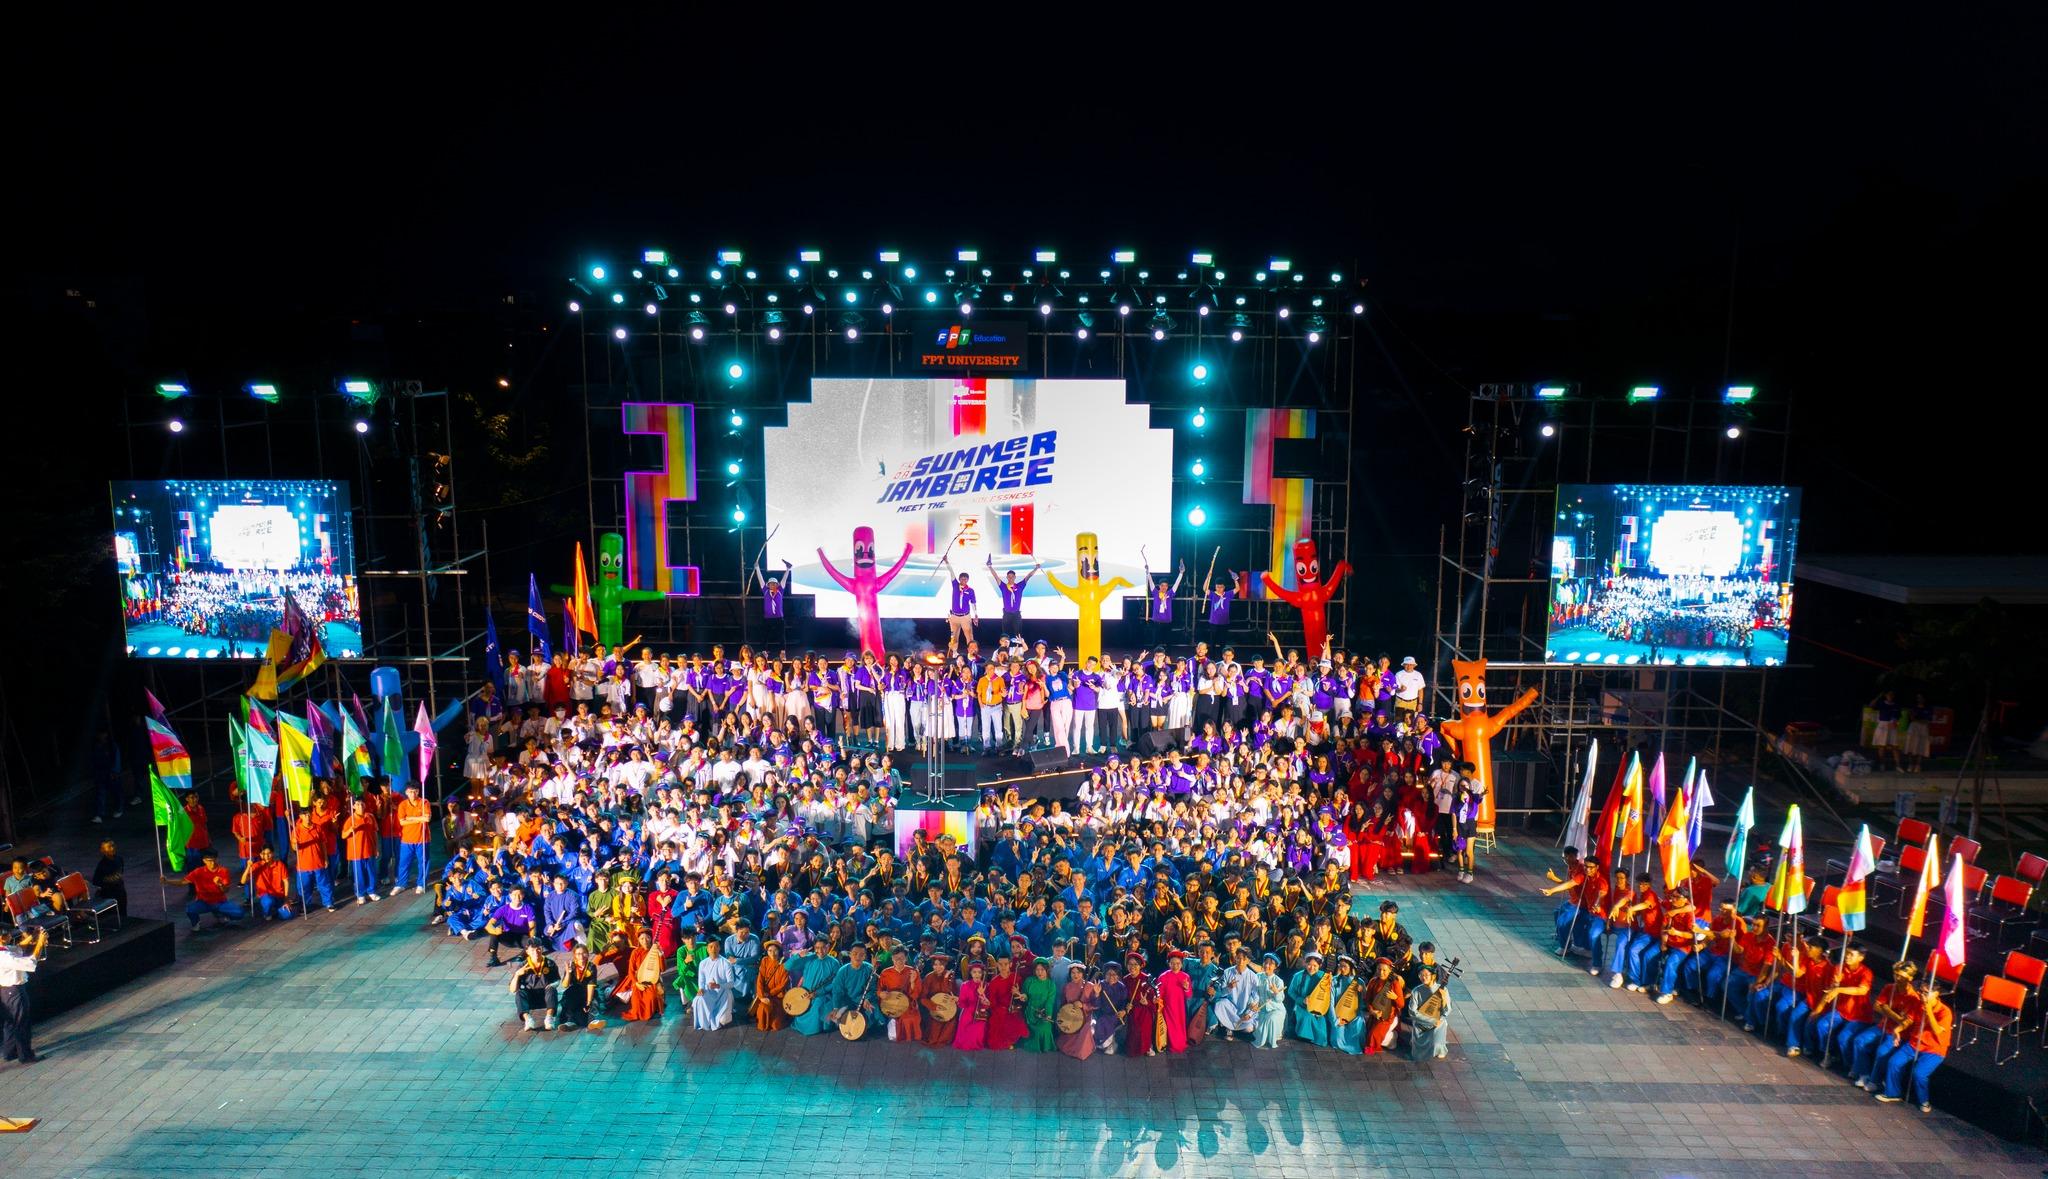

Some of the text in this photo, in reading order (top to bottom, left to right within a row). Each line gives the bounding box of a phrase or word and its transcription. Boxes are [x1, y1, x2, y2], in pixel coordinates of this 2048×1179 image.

[973, 334, 1006, 343] Education
[922, 355, 1020, 366] FPT UNIVERSITY
[897, 503, 924, 513] MEET
[927, 501, 948, 510] THE
